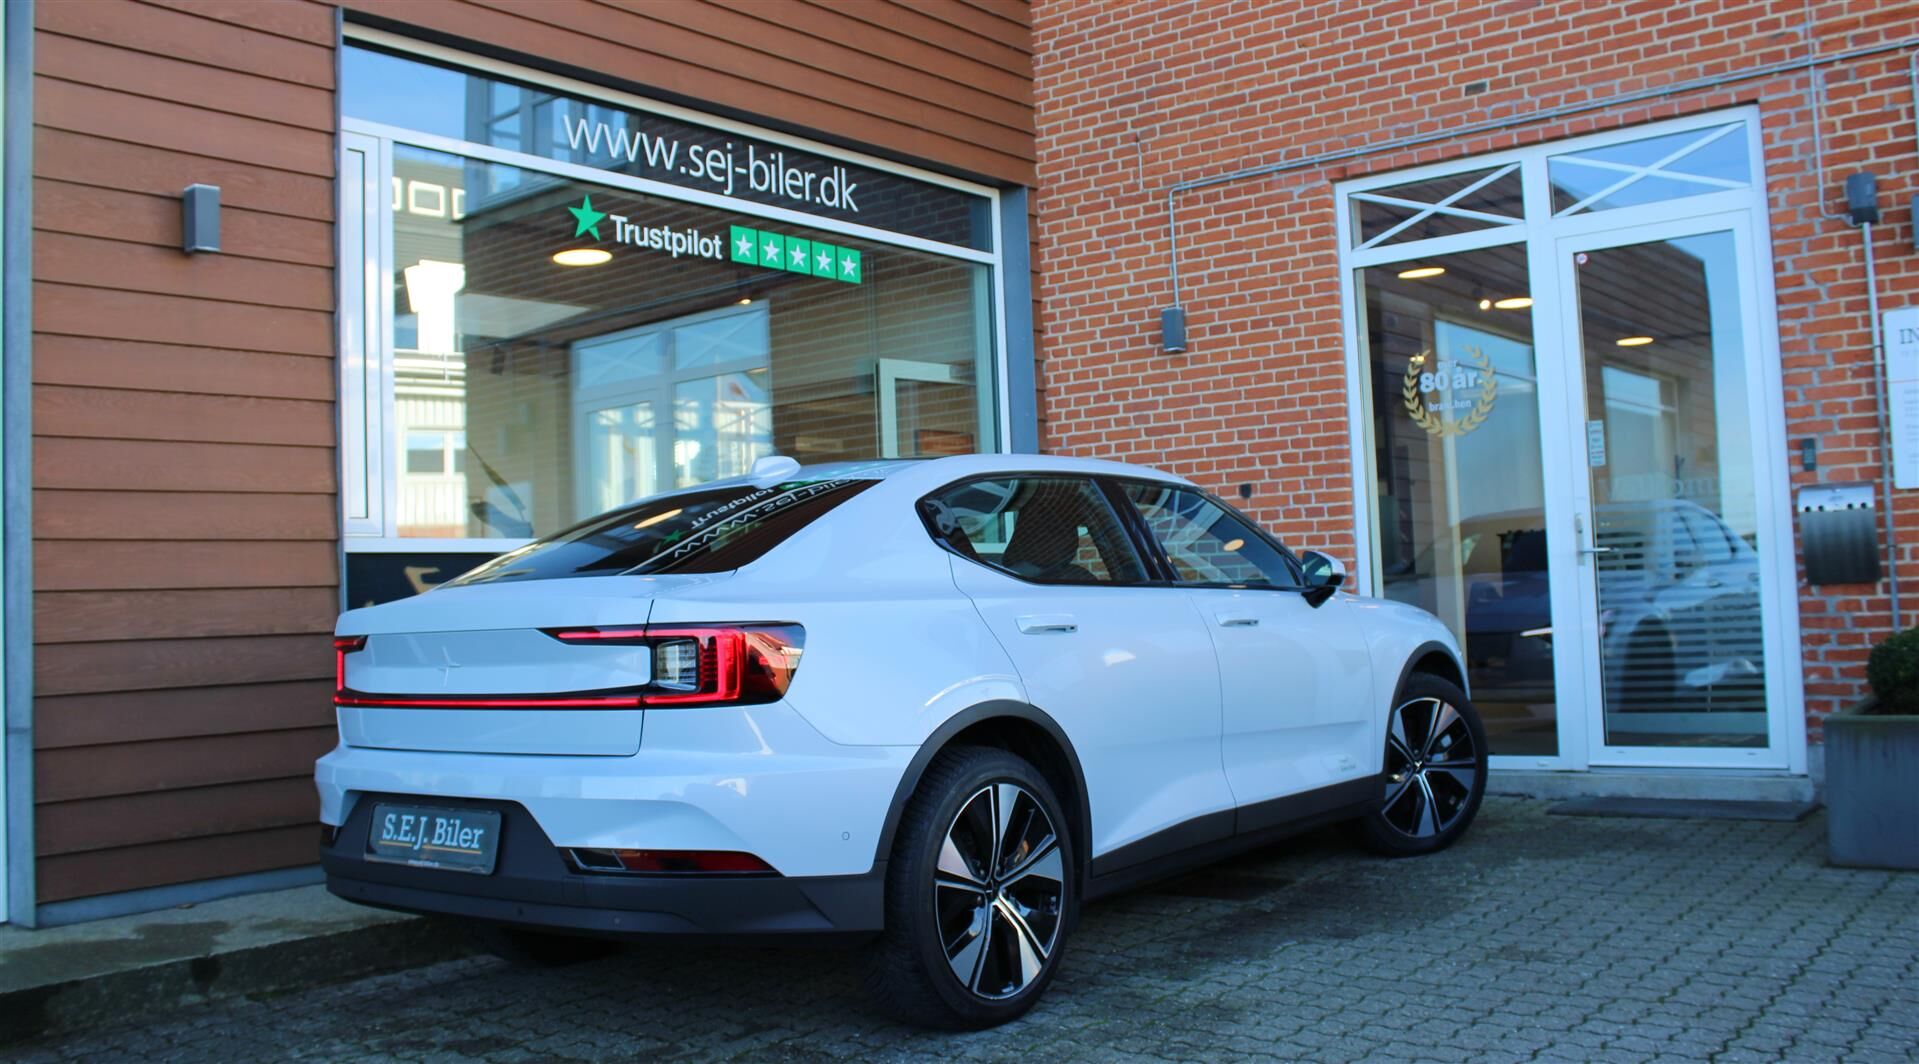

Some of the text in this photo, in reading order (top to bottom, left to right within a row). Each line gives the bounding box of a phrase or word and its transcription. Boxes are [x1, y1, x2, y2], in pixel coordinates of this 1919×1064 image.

[564, 114, 859, 213] www.sej-biler.dk
[609, 213, 723, 260] Trustpilot
[1420, 370, 1449, 393] 80
[382, 813, 484, 850] S.E.J. Biler
